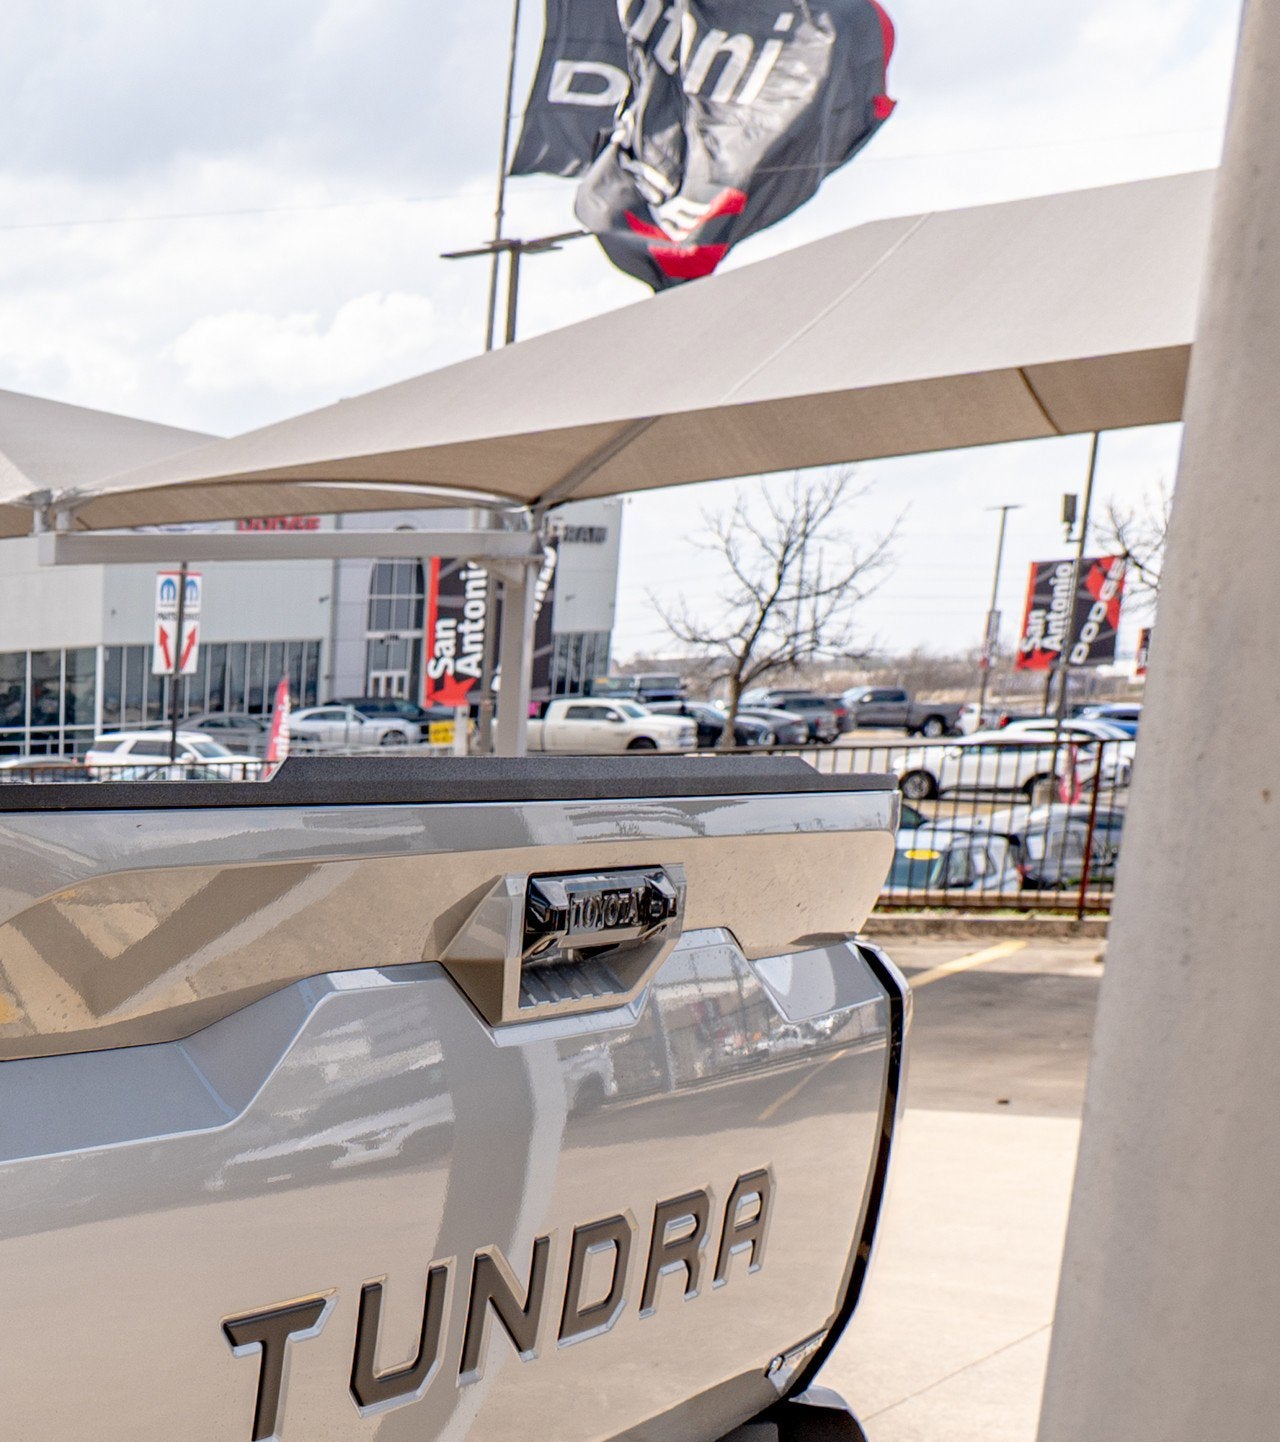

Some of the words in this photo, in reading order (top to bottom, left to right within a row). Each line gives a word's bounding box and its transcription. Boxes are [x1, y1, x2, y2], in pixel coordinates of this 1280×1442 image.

[454, 560, 488, 679] Antoni
[1020, 608, 1048, 653] San
[1040, 562, 1074, 651] Antonio
[1068, 556, 1127, 666] DODGE
[427, 617, 457, 680] San
[571, 886, 644, 929] TOYOTA
